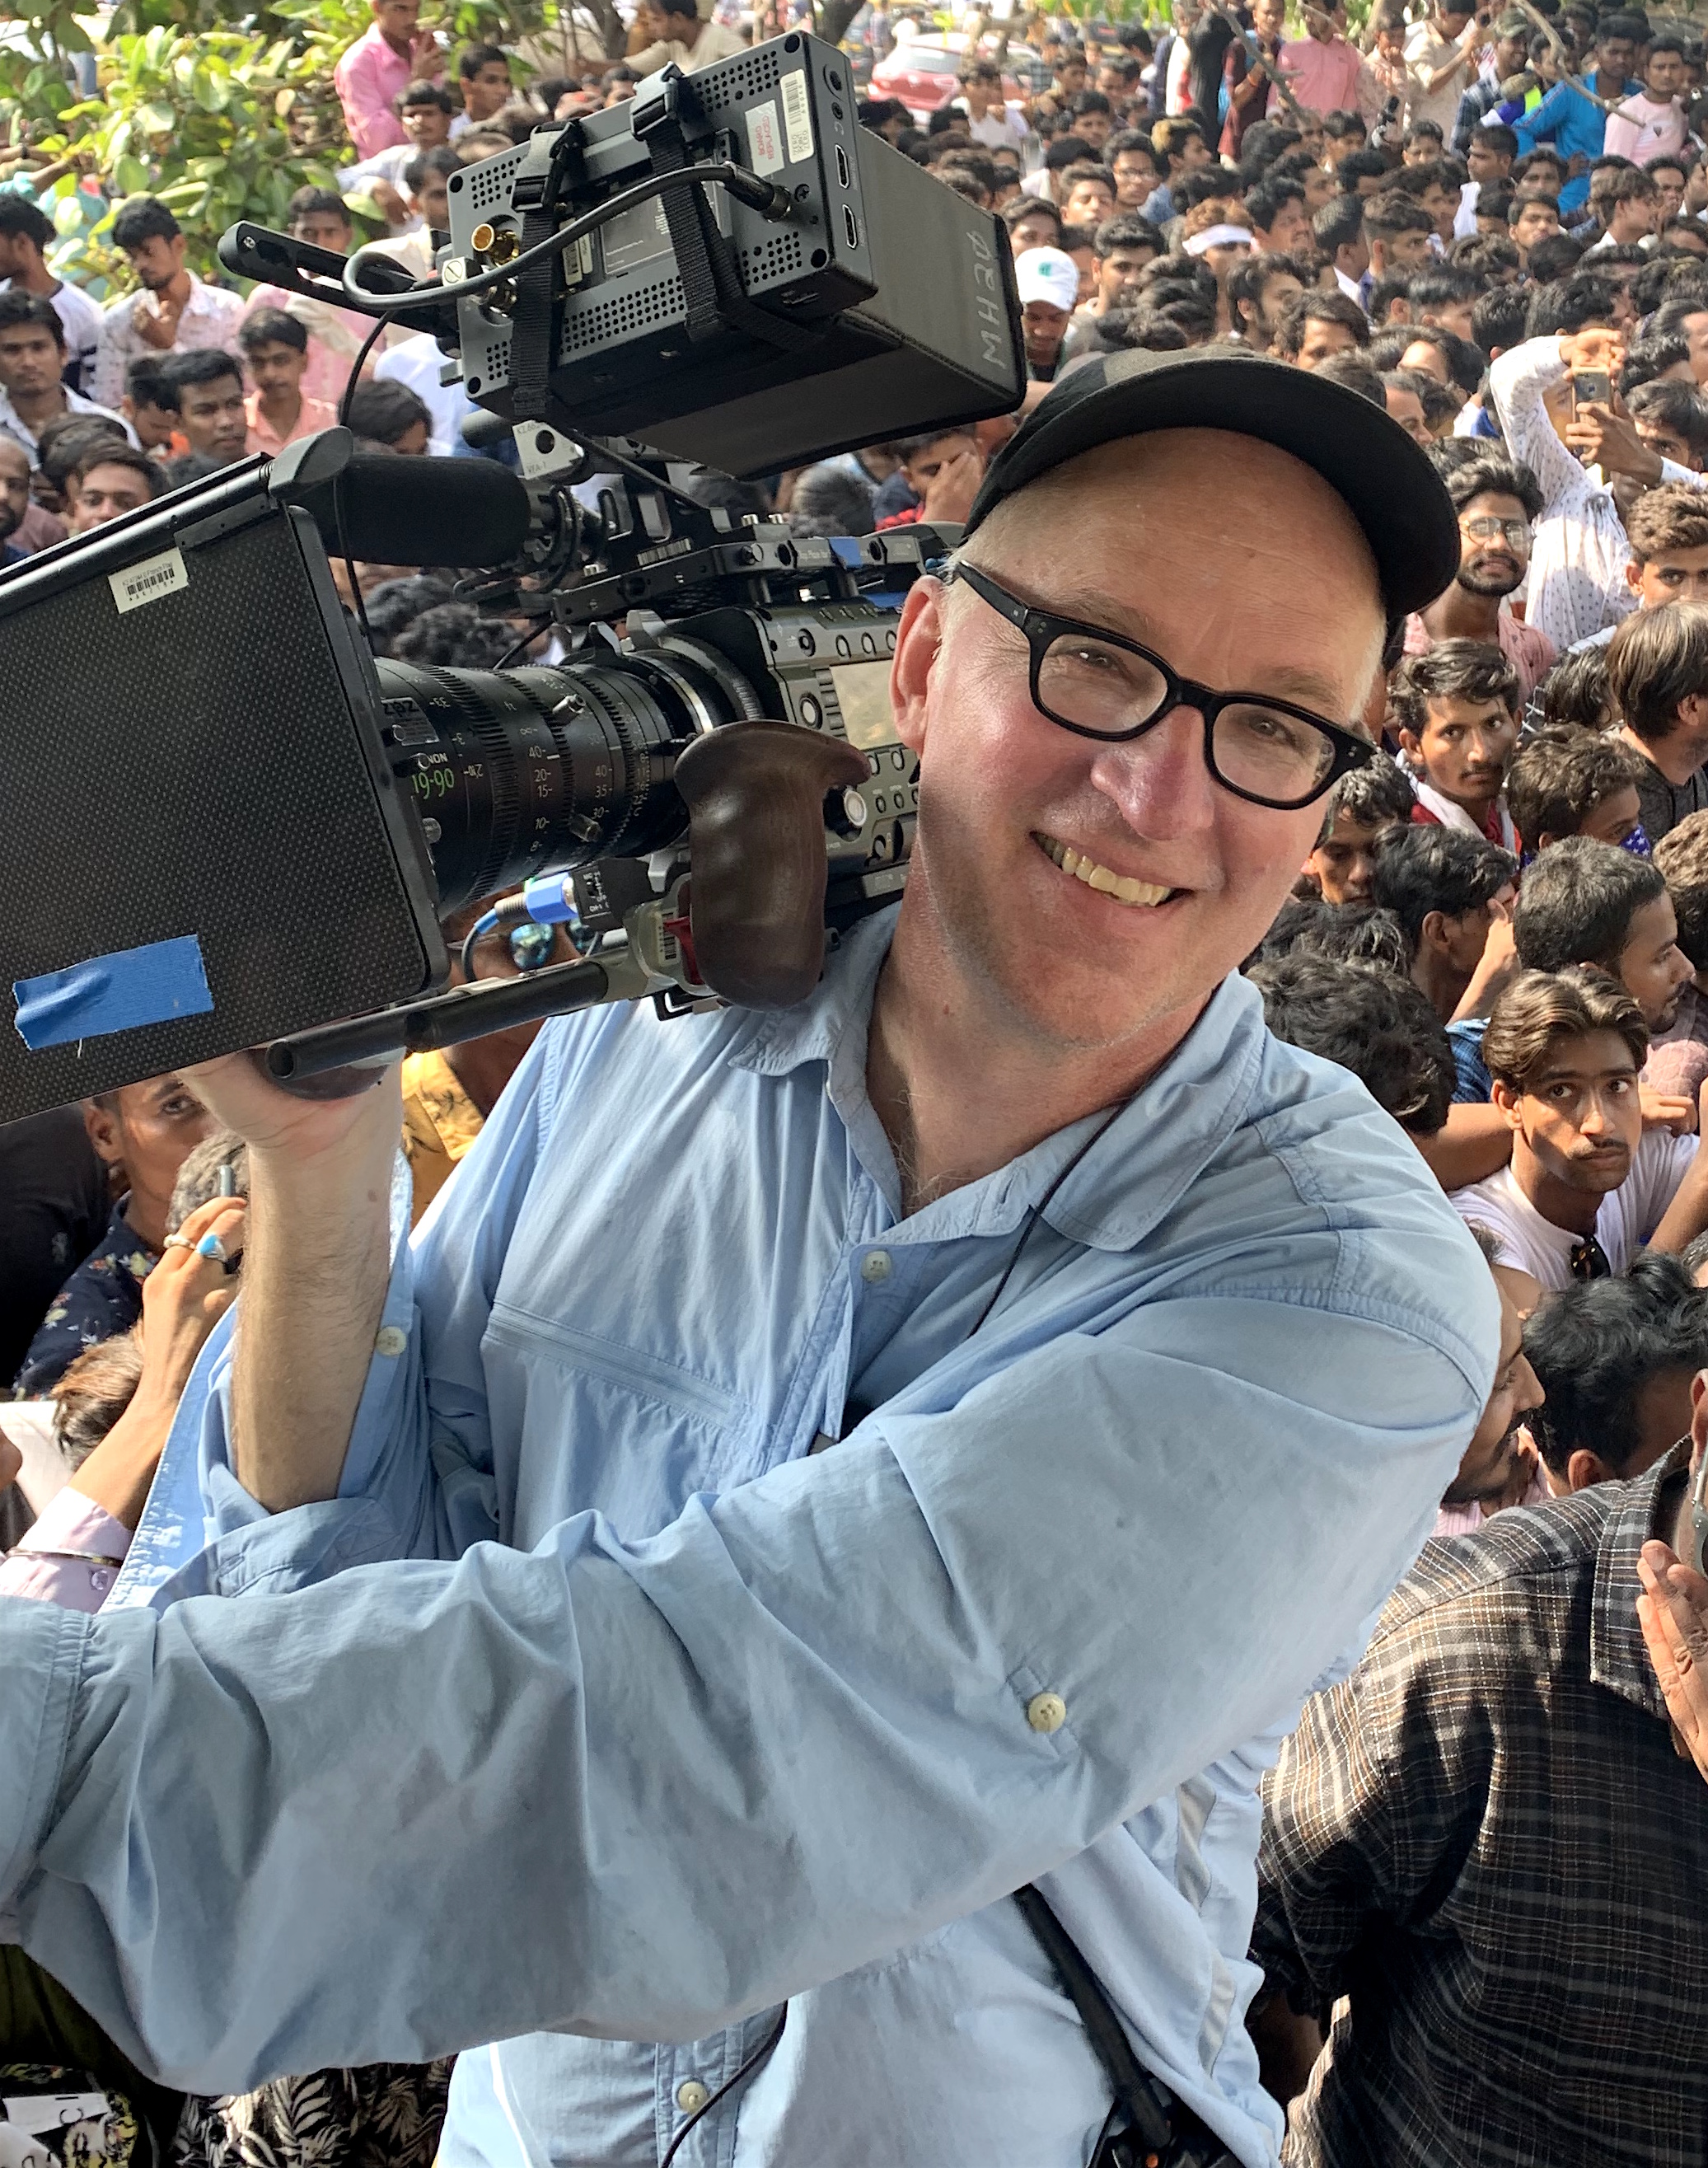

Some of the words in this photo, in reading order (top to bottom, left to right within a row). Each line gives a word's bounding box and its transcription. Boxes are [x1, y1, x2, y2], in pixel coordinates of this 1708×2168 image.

[755, 124, 765, 156] BOARD
[761, 115, 774, 160] REPLACED
[529, 745, 543, 758] 40
[534, 768, 548, 781] 20
[595, 765, 607, 778] 40
[412, 768, 454, 799] 19-90
[537, 784, 549, 798] 15
[595, 784, 608, 798] 35
[592, 806, 606, 820] 30
[536, 818, 547, 831] 10
[530, 841, 539, 853] 8
